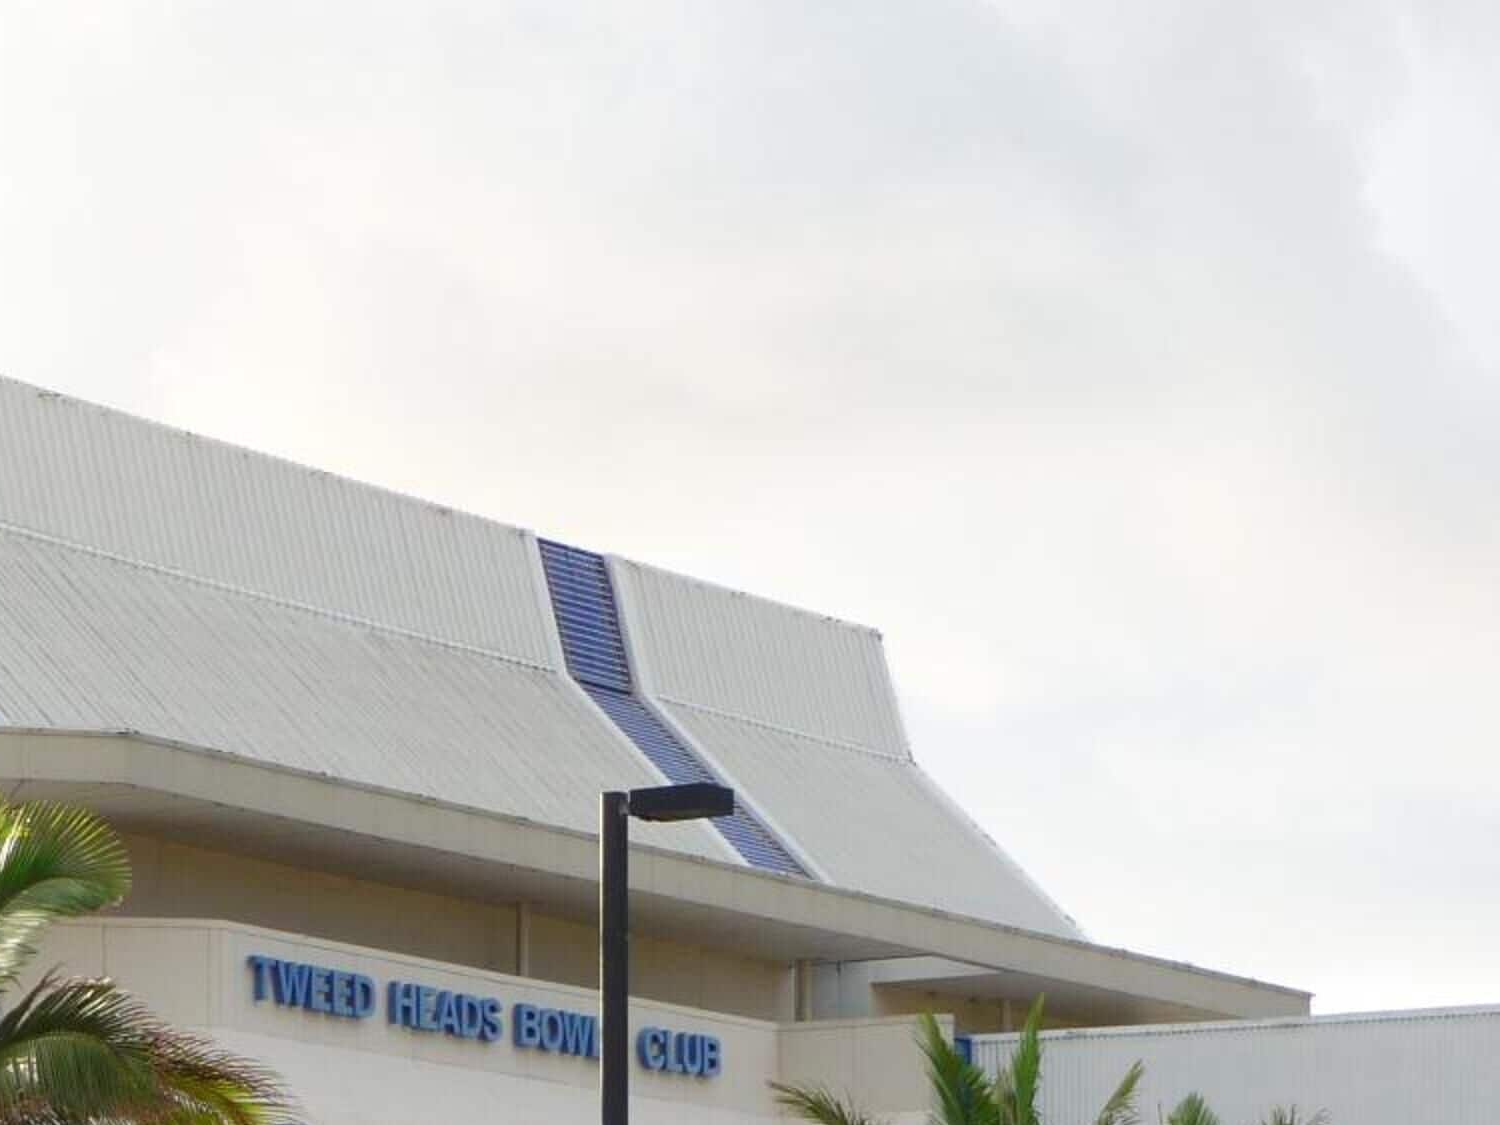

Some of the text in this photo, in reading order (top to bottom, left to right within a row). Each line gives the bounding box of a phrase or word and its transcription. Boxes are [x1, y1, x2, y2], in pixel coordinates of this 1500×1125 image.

[248, 955, 374, 1018] TWEED
[388, 980, 501, 1041] HEADS
[636, 1025, 722, 1077] CLUB
